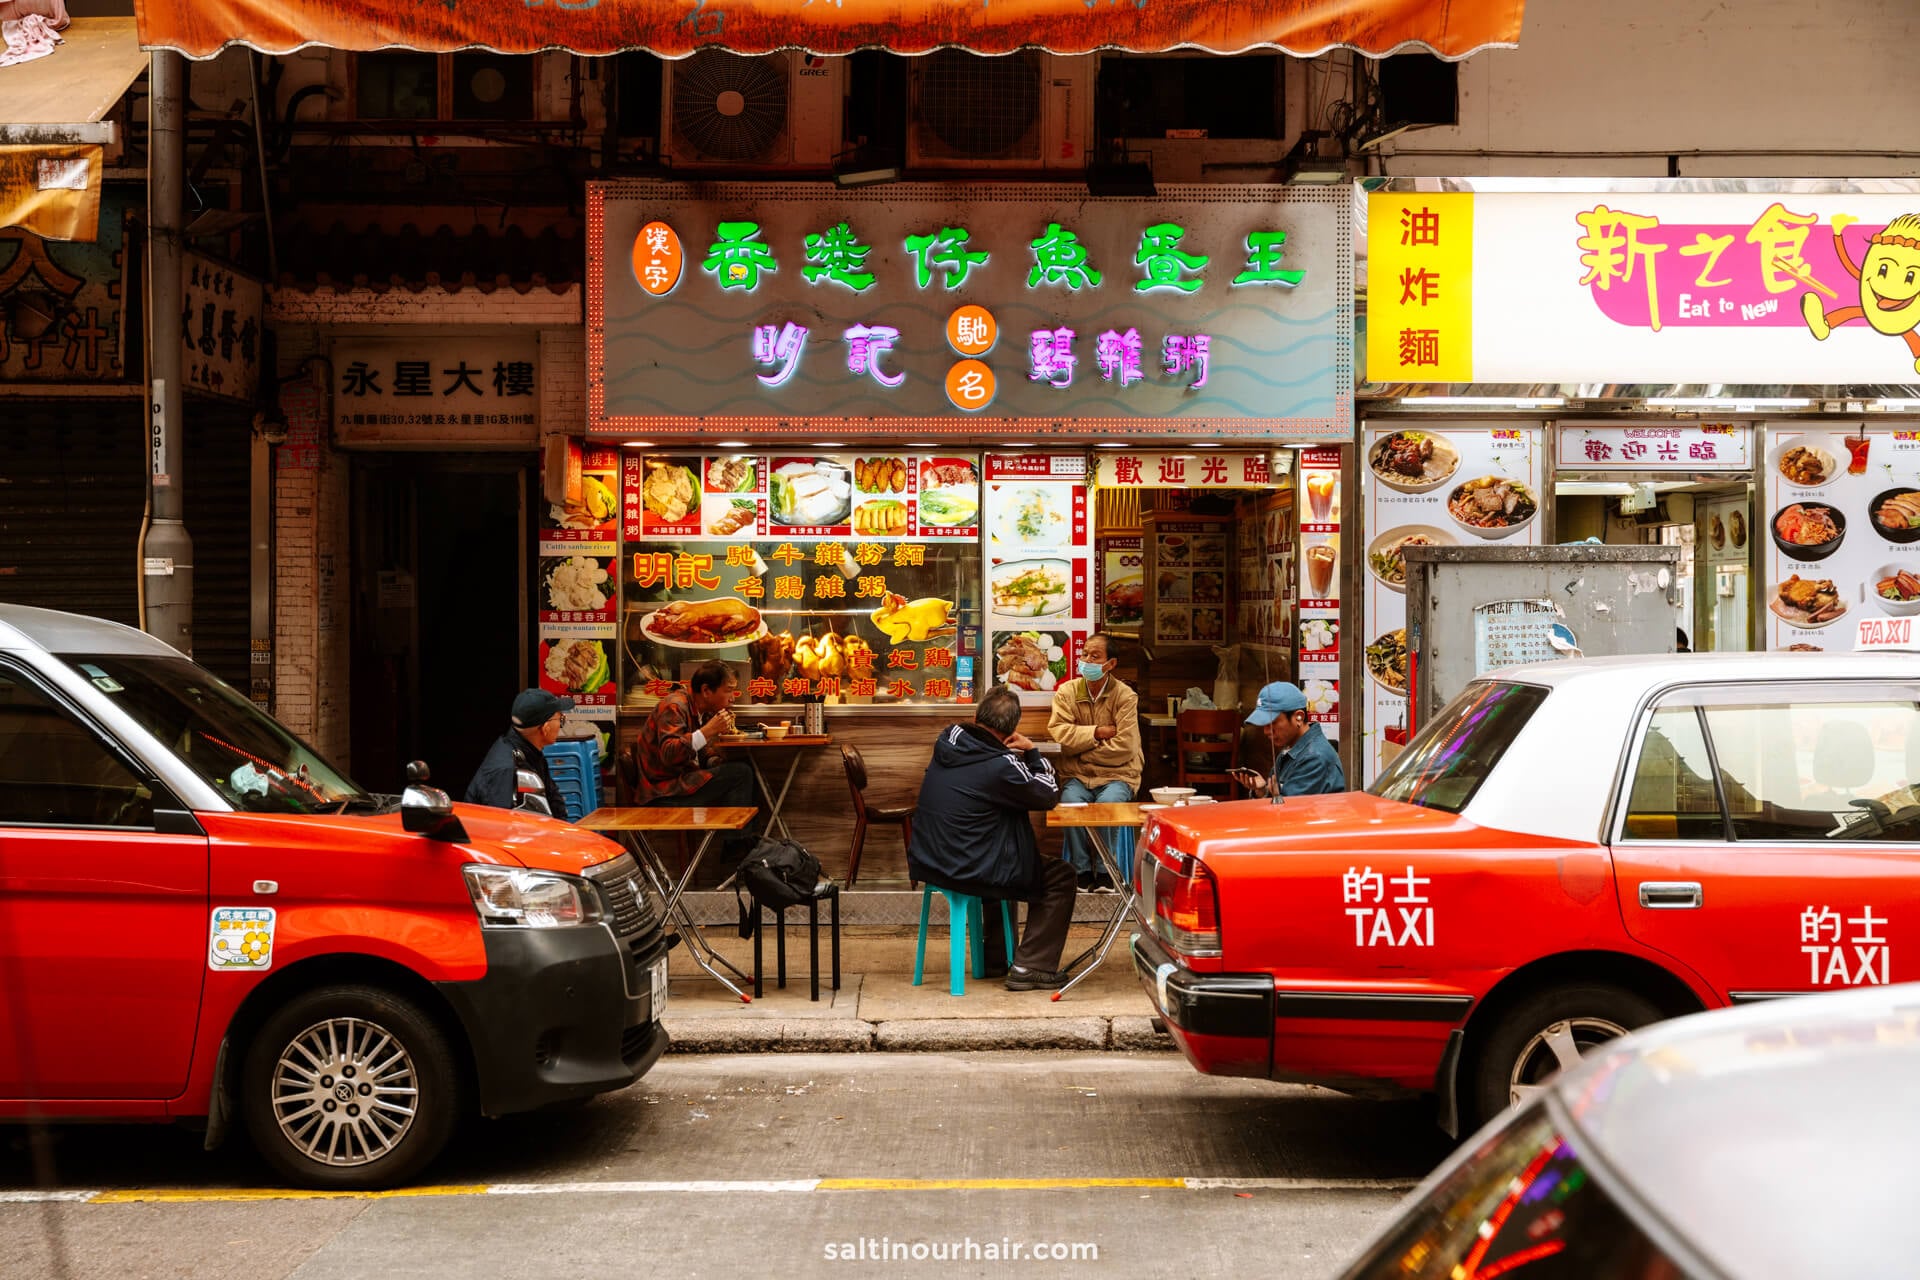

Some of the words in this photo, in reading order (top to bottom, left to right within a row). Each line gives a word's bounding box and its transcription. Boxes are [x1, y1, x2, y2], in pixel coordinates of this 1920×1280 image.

[799, 69, 829, 77] GREE
[645, 227, 672, 288] 漢字
[1576, 203, 1819, 332] 新之食
[1399, 207, 1440, 366] 油炸麵
[1678, 293, 1711, 319] Eat
[1718, 297, 1735, 311] to
[1741, 297, 1779, 321] New
[753, 321, 905, 386] 明記
[956, 316, 988, 400] 馳名
[342, 361, 535, 397] 永星大樓
[1585, 440, 1717, 461] 歡迎光臨
[1624, 429, 1683, 438] WELCOME
[1115, 457, 1270, 484] 歡迎光臨
[634, 553, 721, 590] 明記
[772, 542, 926, 567] 牛雜粉麵
[1859, 619, 1911, 645] TAXI
[1342, 865, 1431, 904] 的士
[1345, 907, 1435, 947] TAXI
[1800, 905, 1888, 944] 的士
[1801, 945, 1890, 985] TAXI
